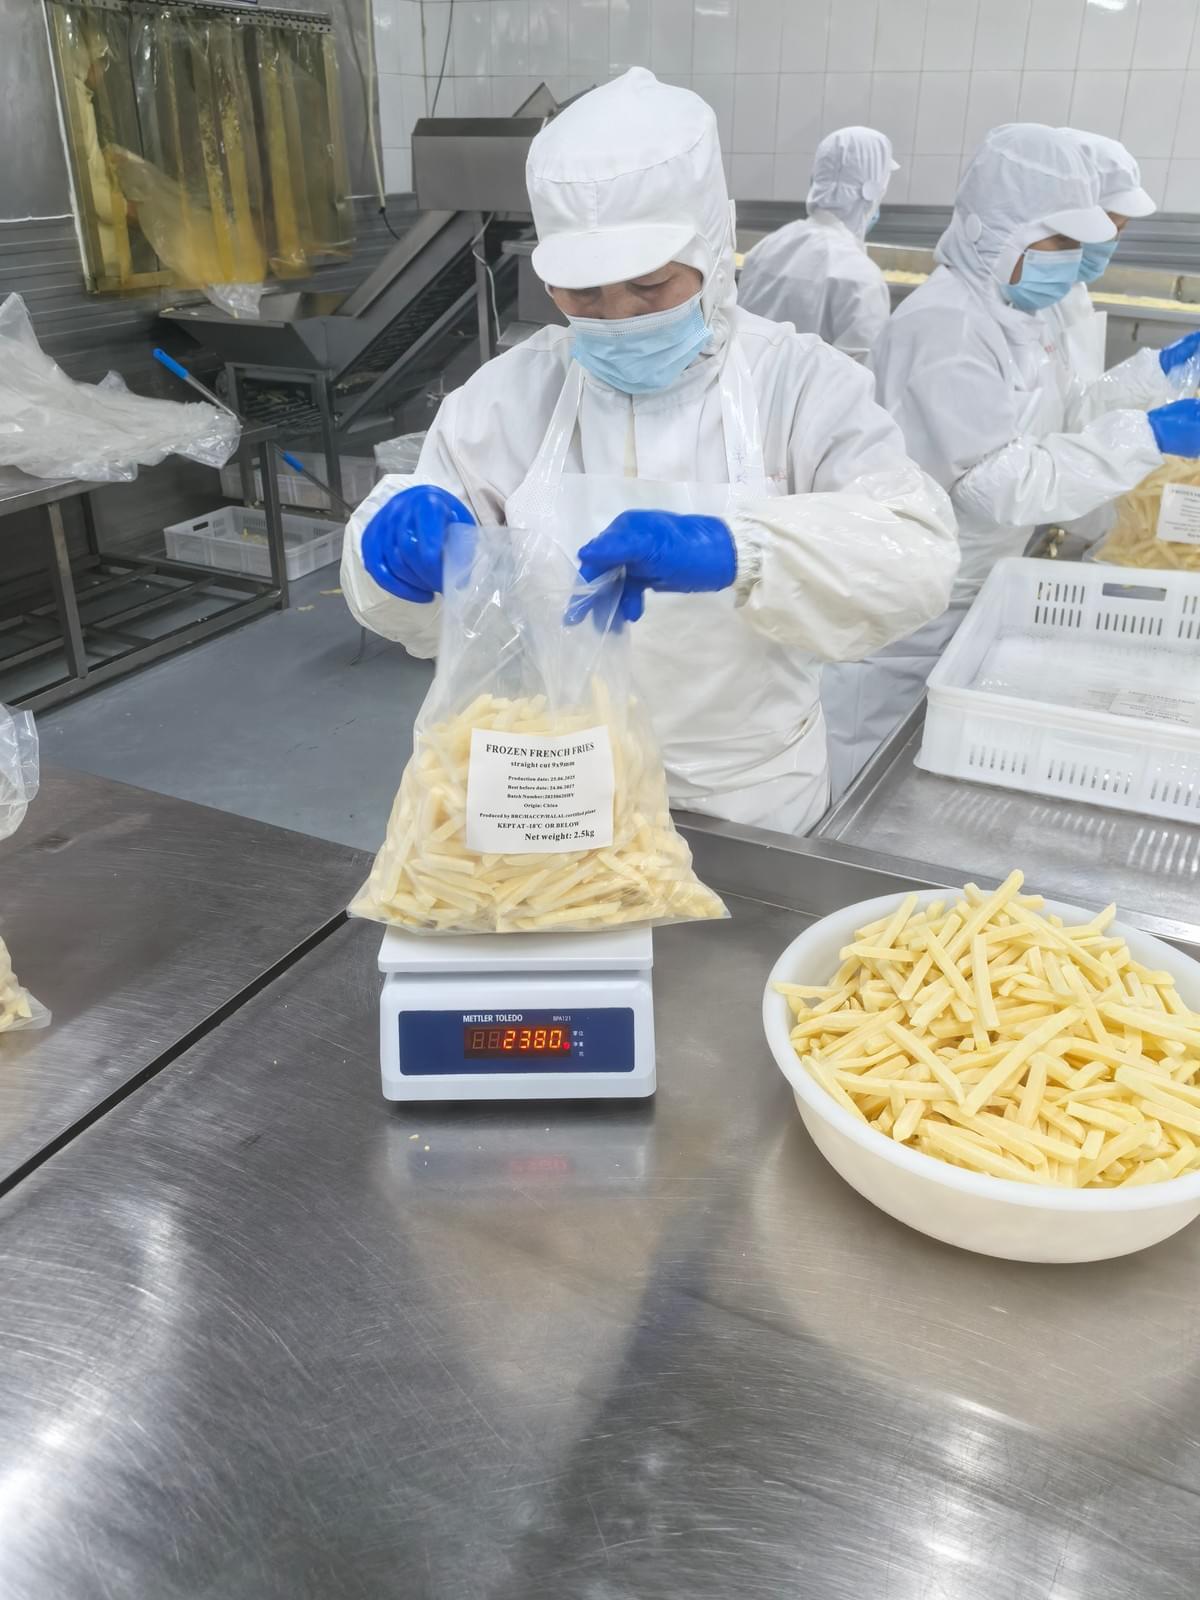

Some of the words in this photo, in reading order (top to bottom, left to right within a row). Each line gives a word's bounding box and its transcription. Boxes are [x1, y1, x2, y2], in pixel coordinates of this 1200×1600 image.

[486, 743, 527, 757] FROZEN
[529, 748, 570, 758] FRENCH
[572, 742, 595, 755] FRIES
[511, 761, 538, 769] straight
[525, 832, 540, 841] Net
[541, 832, 572, 842] weight:
[574, 829, 595, 839] 2.5kg
[495, 1014, 523, 1022] TOLEDO
